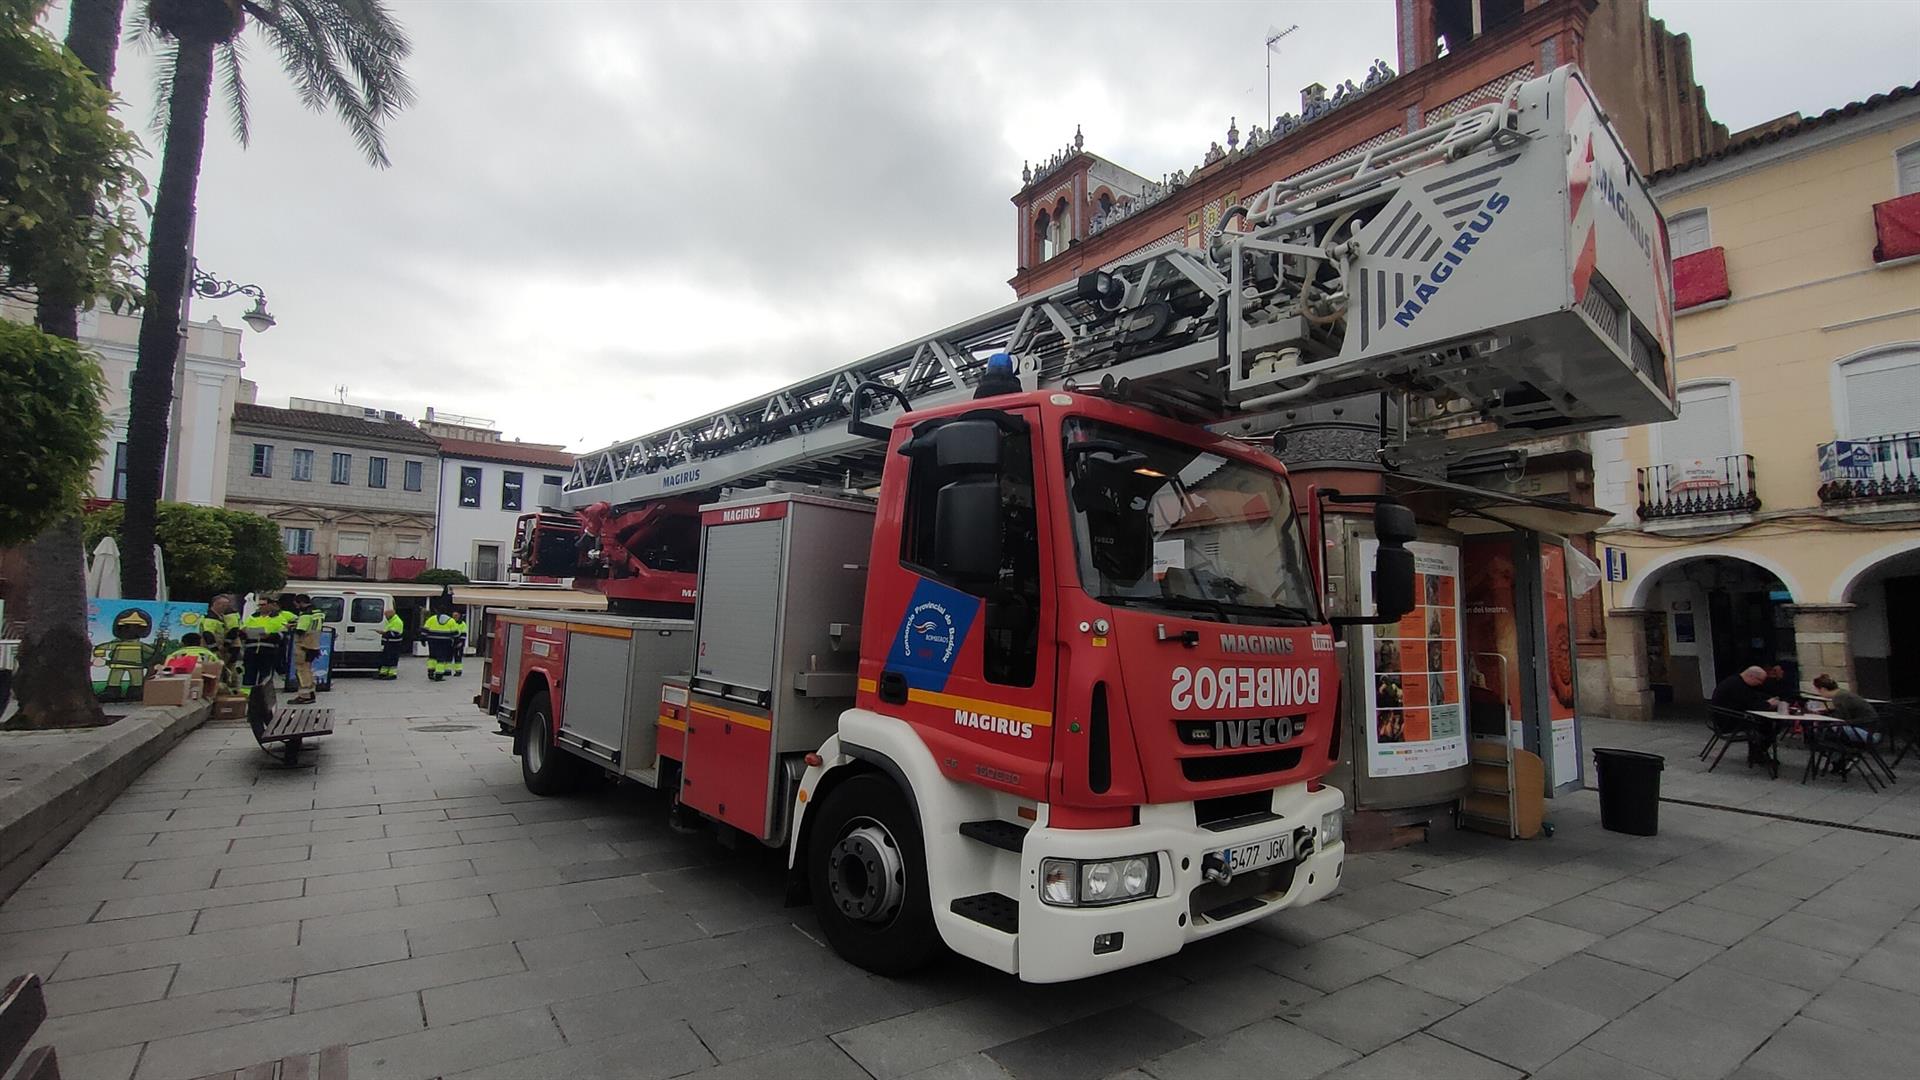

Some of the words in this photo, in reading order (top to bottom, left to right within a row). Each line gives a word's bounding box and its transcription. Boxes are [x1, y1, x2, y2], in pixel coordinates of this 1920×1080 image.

[1596, 167, 1652, 260] MAGIRUS
[1394, 191, 1510, 328] MAGIRUS
[663, 469, 700, 488] MAGIRUS
[723, 507, 760, 522] MAGIRUS
[914, 601, 946, 614] Provincial
[942, 627, 955, 663] Badajoz
[1220, 634, 1294, 655] MAGIRUS
[955, 709, 1033, 739] MAGIRUS
[1216, 717, 1293, 750] IVECO
[1231, 845, 1260, 870] 5477
[1266, 838, 1286, 861] JGK
